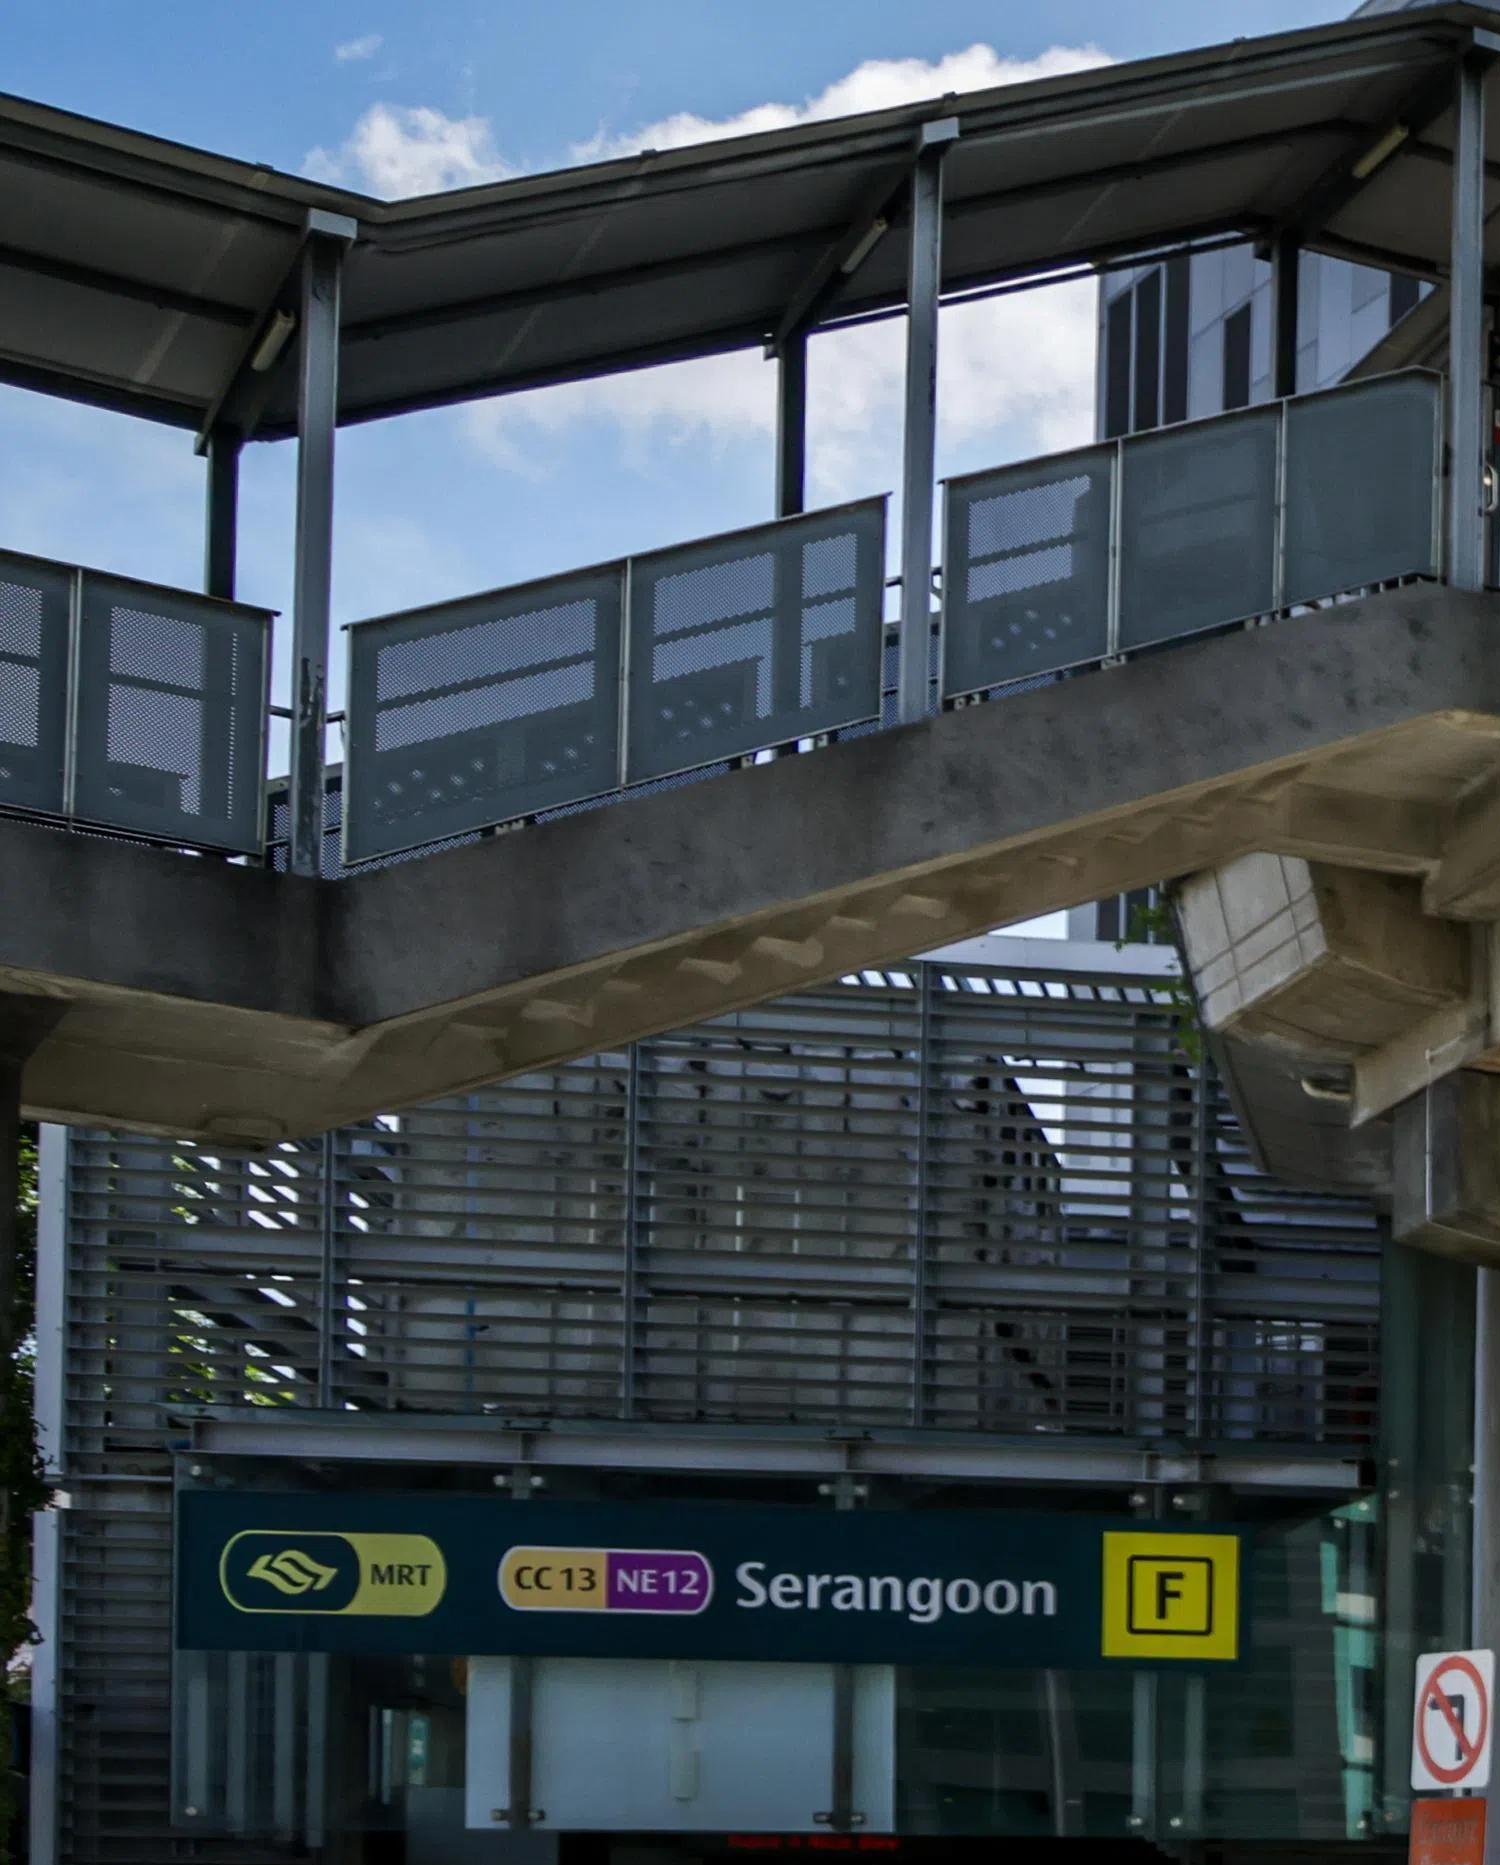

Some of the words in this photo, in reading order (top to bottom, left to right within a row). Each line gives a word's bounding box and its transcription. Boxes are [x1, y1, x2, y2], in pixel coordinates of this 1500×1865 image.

[370, 1563, 432, 1588] MRT
[735, 1561, 1058, 1623] Serangoon
[1155, 1571, 1186, 1619] F
